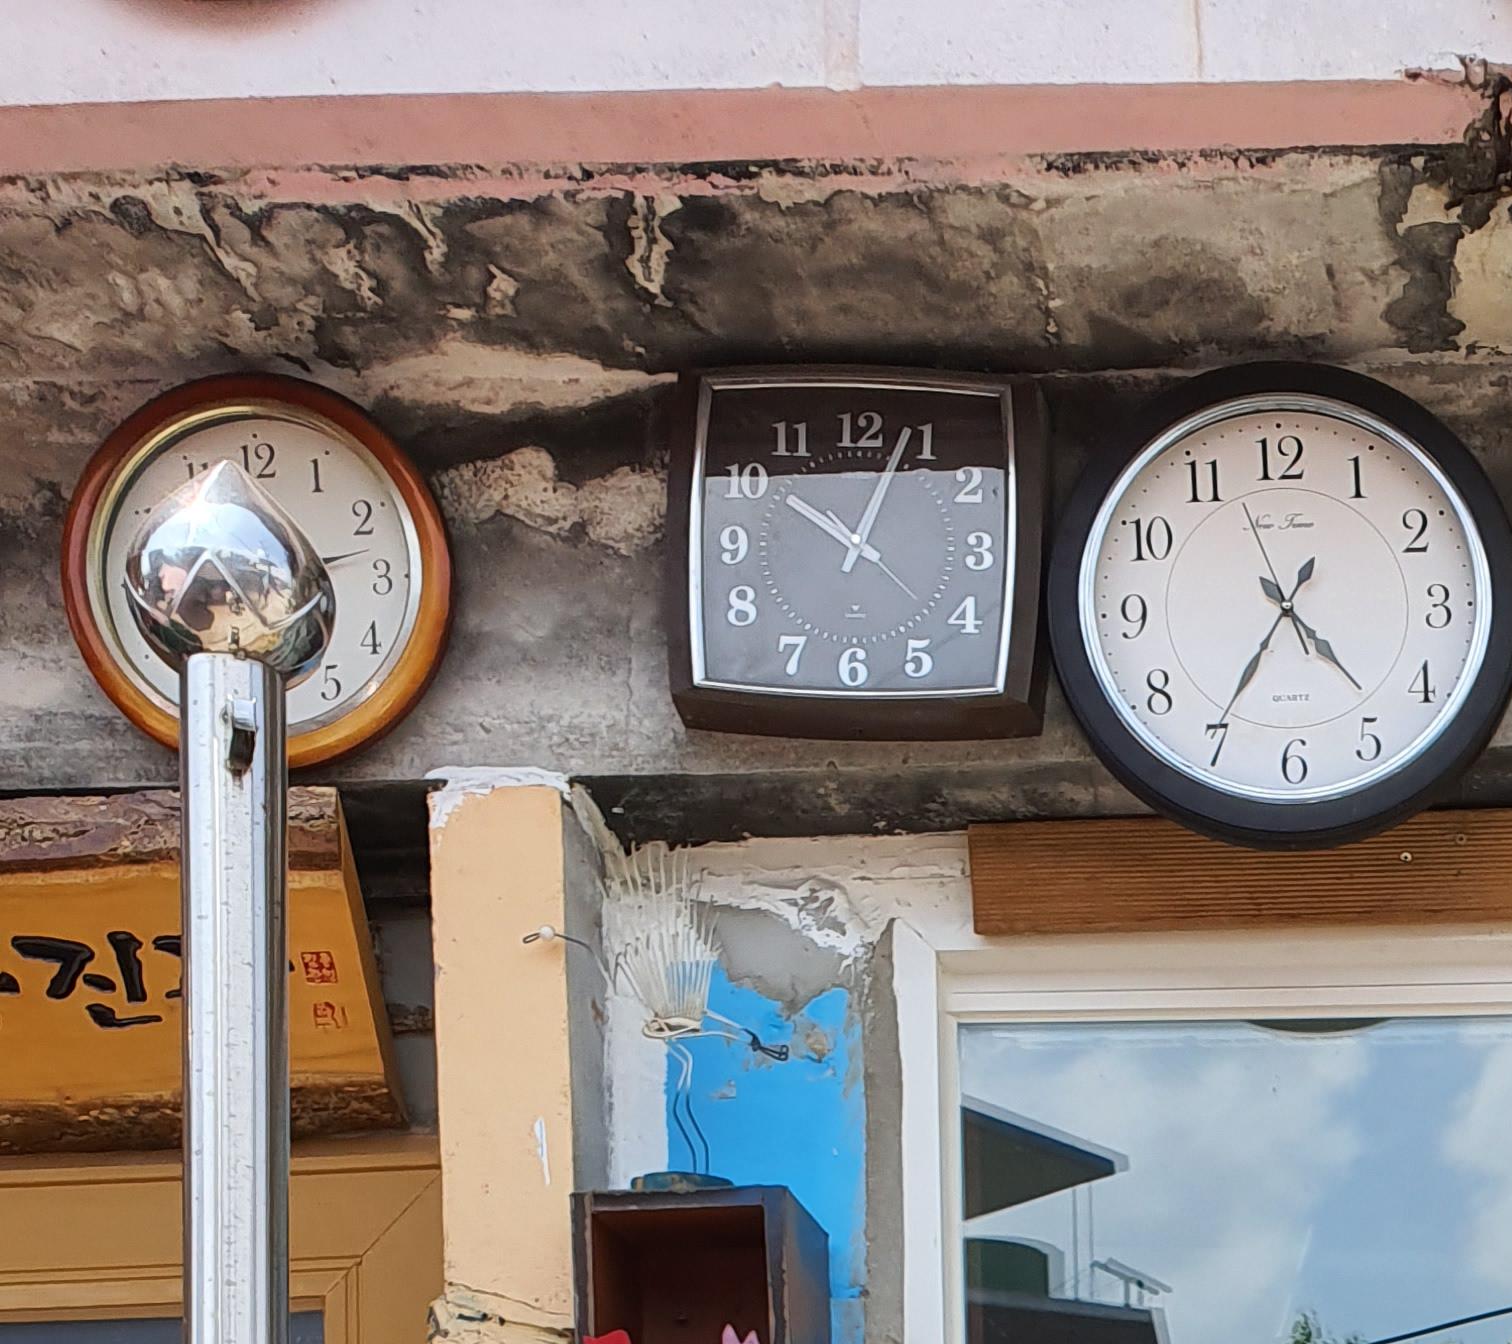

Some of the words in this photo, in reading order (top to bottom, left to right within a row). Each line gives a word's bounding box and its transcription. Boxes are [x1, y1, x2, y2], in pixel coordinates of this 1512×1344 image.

[770, 421, 812, 457] 11
[836, 411, 884, 448] 12
[908, 423, 937, 460] 1
[241, 441, 277, 479] 12
[309, 457, 325, 493] 1
[1255, 434, 1304, 481] 12
[1347, 456, 1368, 498] 1
[723, 462, 769, 499] 10
[953, 467, 984, 504] 2
[1184, 459, 1224, 503] 11
[351, 499, 375, 536] 2
[1401, 508, 1430, 554] 2
[719, 525, 749, 565] 9
[964, 531, 994, 571] 3
[1128, 515, 1174, 562] 10
[371, 559, 394, 595] 3
[726, 585, 758, 627] 8
[947, 595, 983, 635] 4
[1119, 594, 1148, 640] 9
[1424, 583, 1453, 629] 3
[359, 622, 383, 655] 4
[777, 635, 808, 676] 7
[903, 638, 934, 678] 5
[319, 664, 342, 701] 5
[837, 647, 869, 688] 6
[1407, 659, 1437, 703] 4
[1146, 668, 1173, 715] 8
[1271, 692, 1311, 702] QUARTZ
[1204, 722, 1230, 767] 7
[1354, 716, 1383, 761] 5
[1280, 737, 1309, 784] 6
